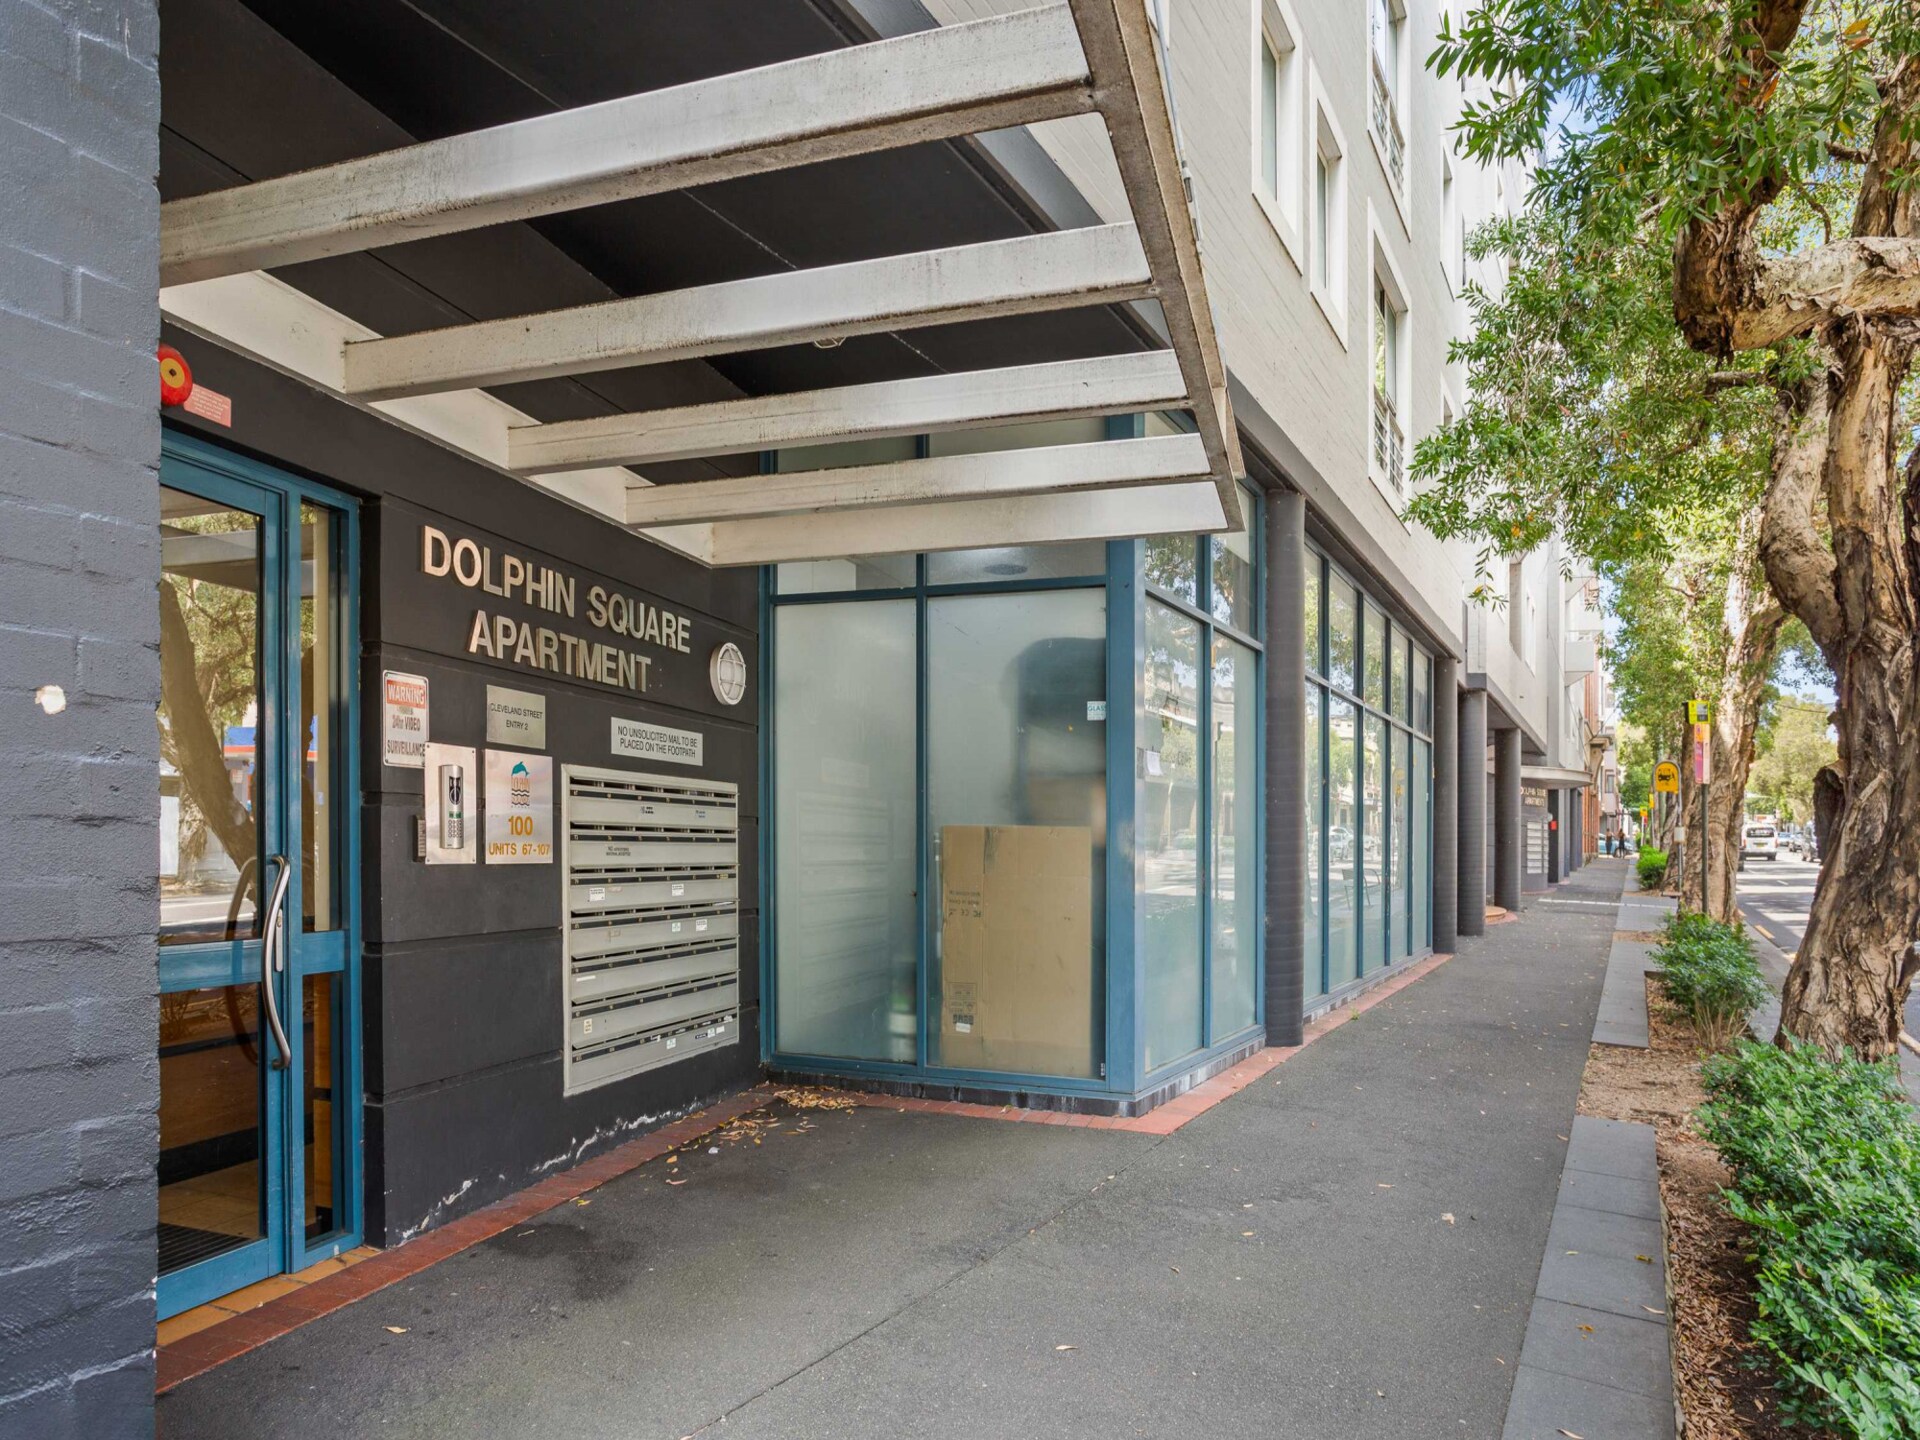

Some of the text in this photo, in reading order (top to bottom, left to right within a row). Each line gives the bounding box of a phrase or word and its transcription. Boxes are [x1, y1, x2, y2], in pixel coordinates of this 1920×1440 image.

[422, 525, 691, 653] DOLPHIN SQUARE
[468, 609, 651, 692] APARTMENT
[387, 684, 425, 704] WARNING
[490, 703, 543, 720] CLEVELAND STREET
[404, 716, 421, 731] VIDEO
[506, 720, 529, 731] ENTRY 2
[617, 725, 698, 748] NO UNSOLICITED MAIL TO BE
[387, 739, 425, 757] SURVEILLANCE
[620, 738, 696, 758] PLACED ON THE FOOTPATH
[508, 815, 534, 836] 100
[488, 842, 551, 856] UNITS 67-107
